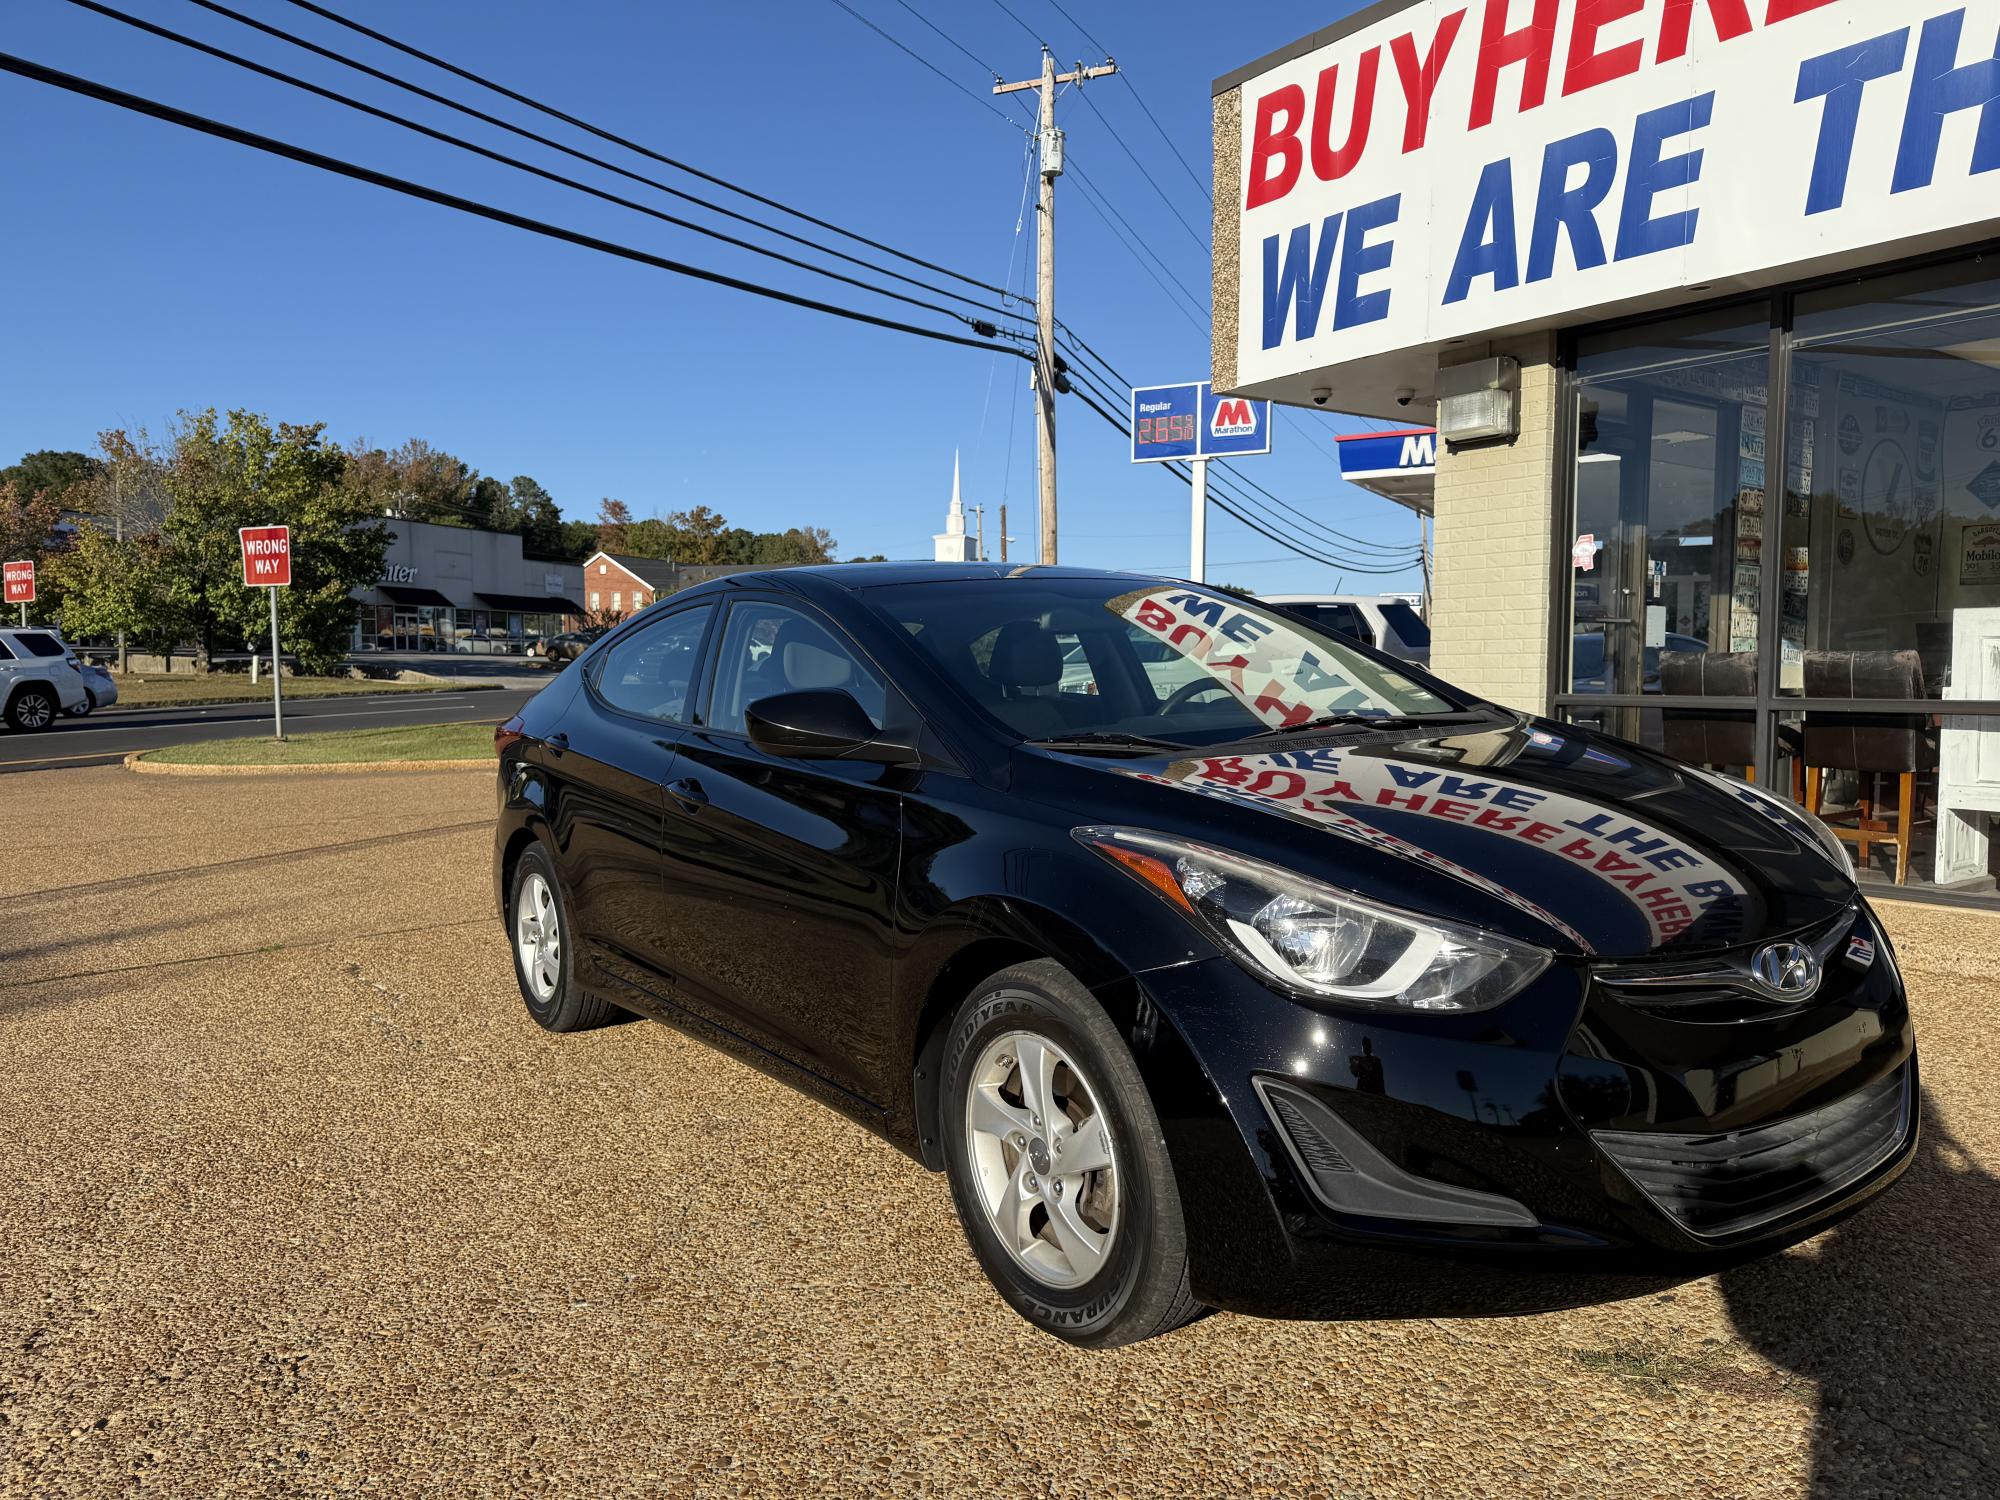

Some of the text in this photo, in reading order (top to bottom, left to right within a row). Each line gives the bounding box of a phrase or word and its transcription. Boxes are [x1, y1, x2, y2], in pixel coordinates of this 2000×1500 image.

[1246, 8, 1466, 211] BUY
[1261, 192, 1401, 351] WE
[1442, 90, 1716, 305] ARE
[1140, 401, 1172, 413] Regular
[1214, 425, 1253, 435] Marathon
[1399, 435, 1437, 466] M
[246, 538, 287, 555] WRONG
[255, 559, 280, 574] WAY
[5, 570, 32, 581] WRONG
[10, 583, 28, 594] WAY
